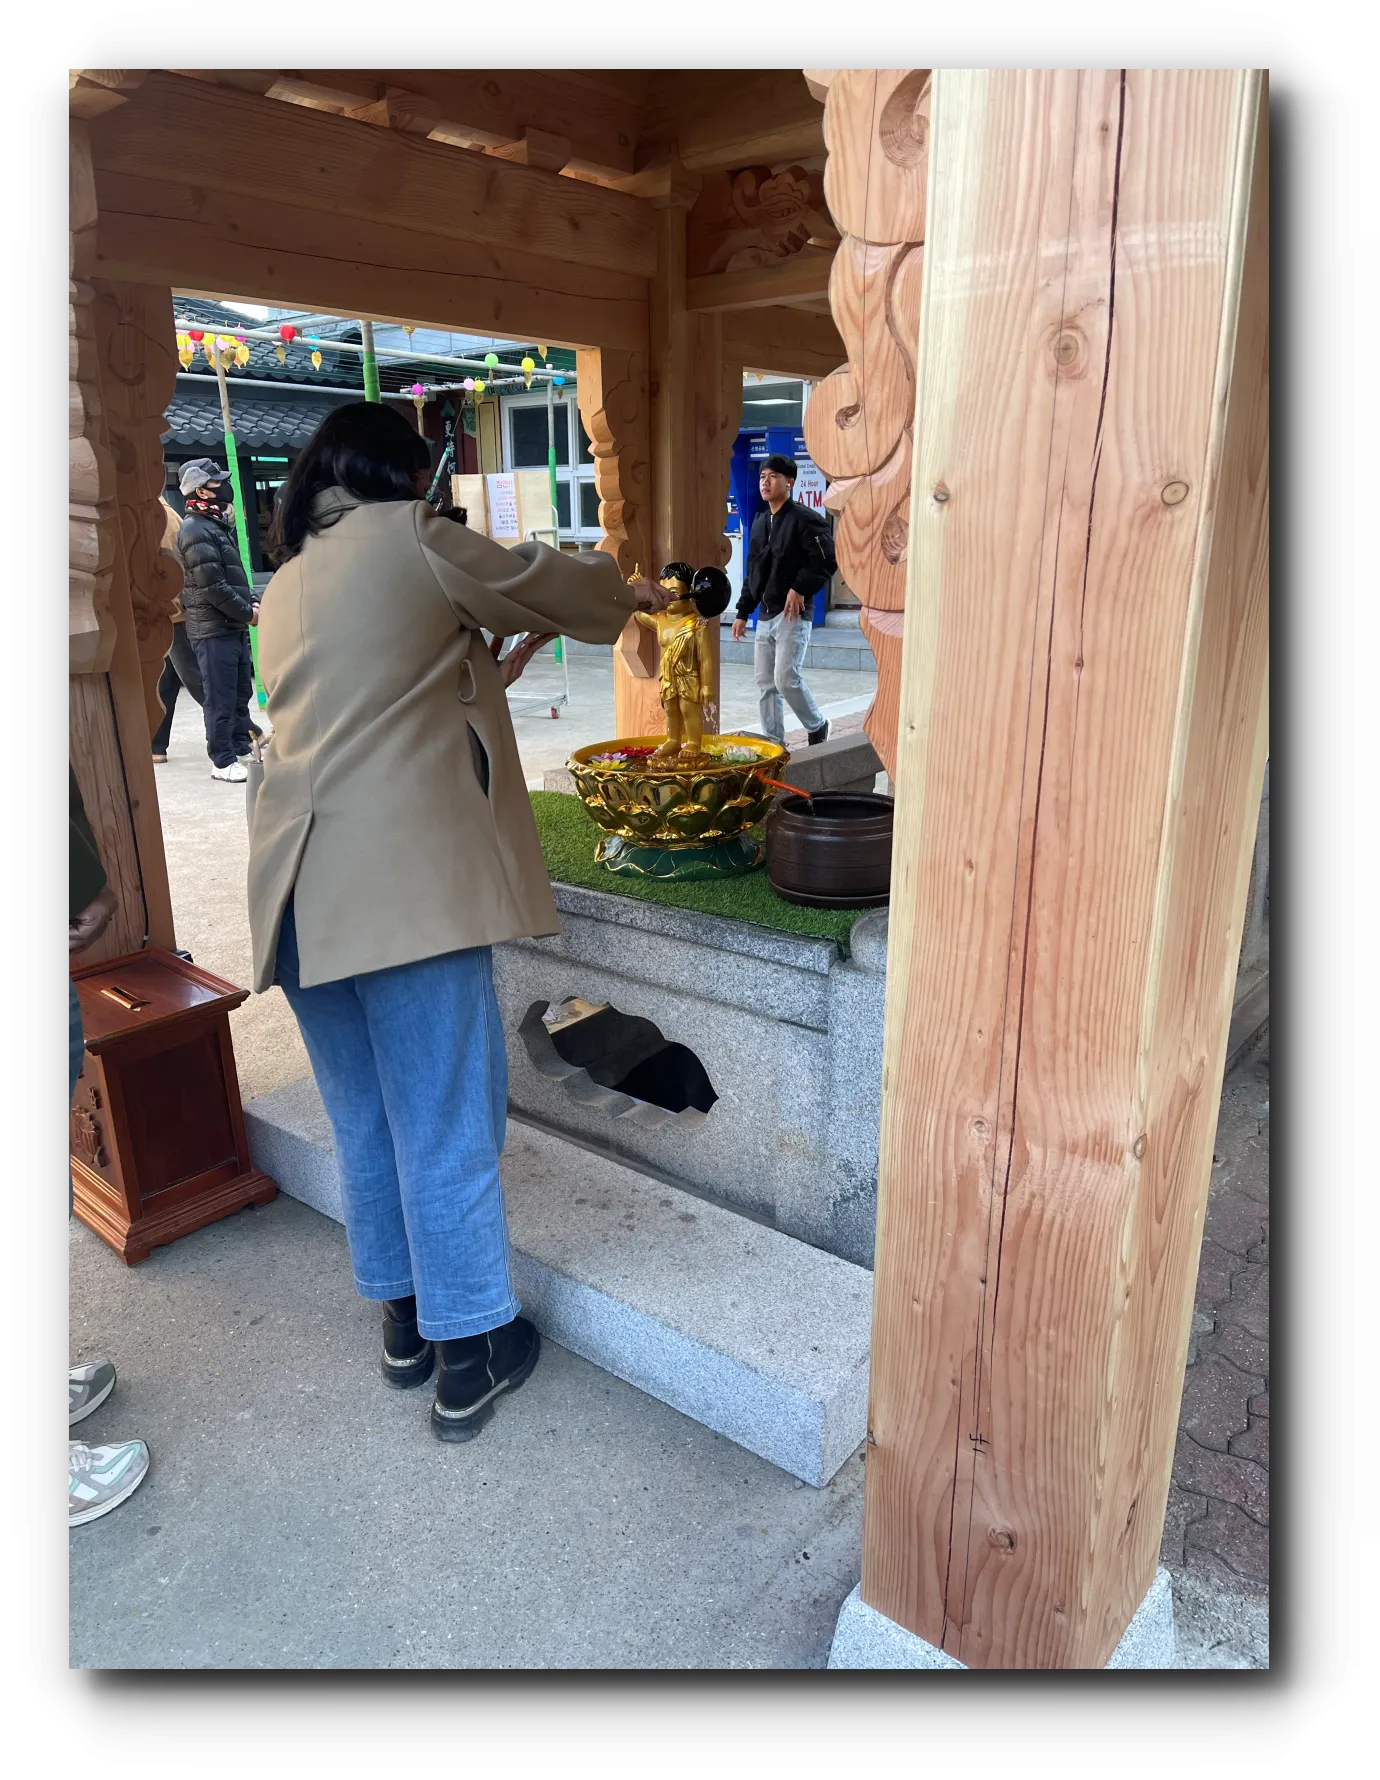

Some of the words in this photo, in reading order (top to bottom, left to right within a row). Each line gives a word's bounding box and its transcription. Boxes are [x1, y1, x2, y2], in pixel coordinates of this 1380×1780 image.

[800, 480, 807, 488] 24
[808, 480, 819, 488] Hour
[798, 491, 822, 508] ATM
